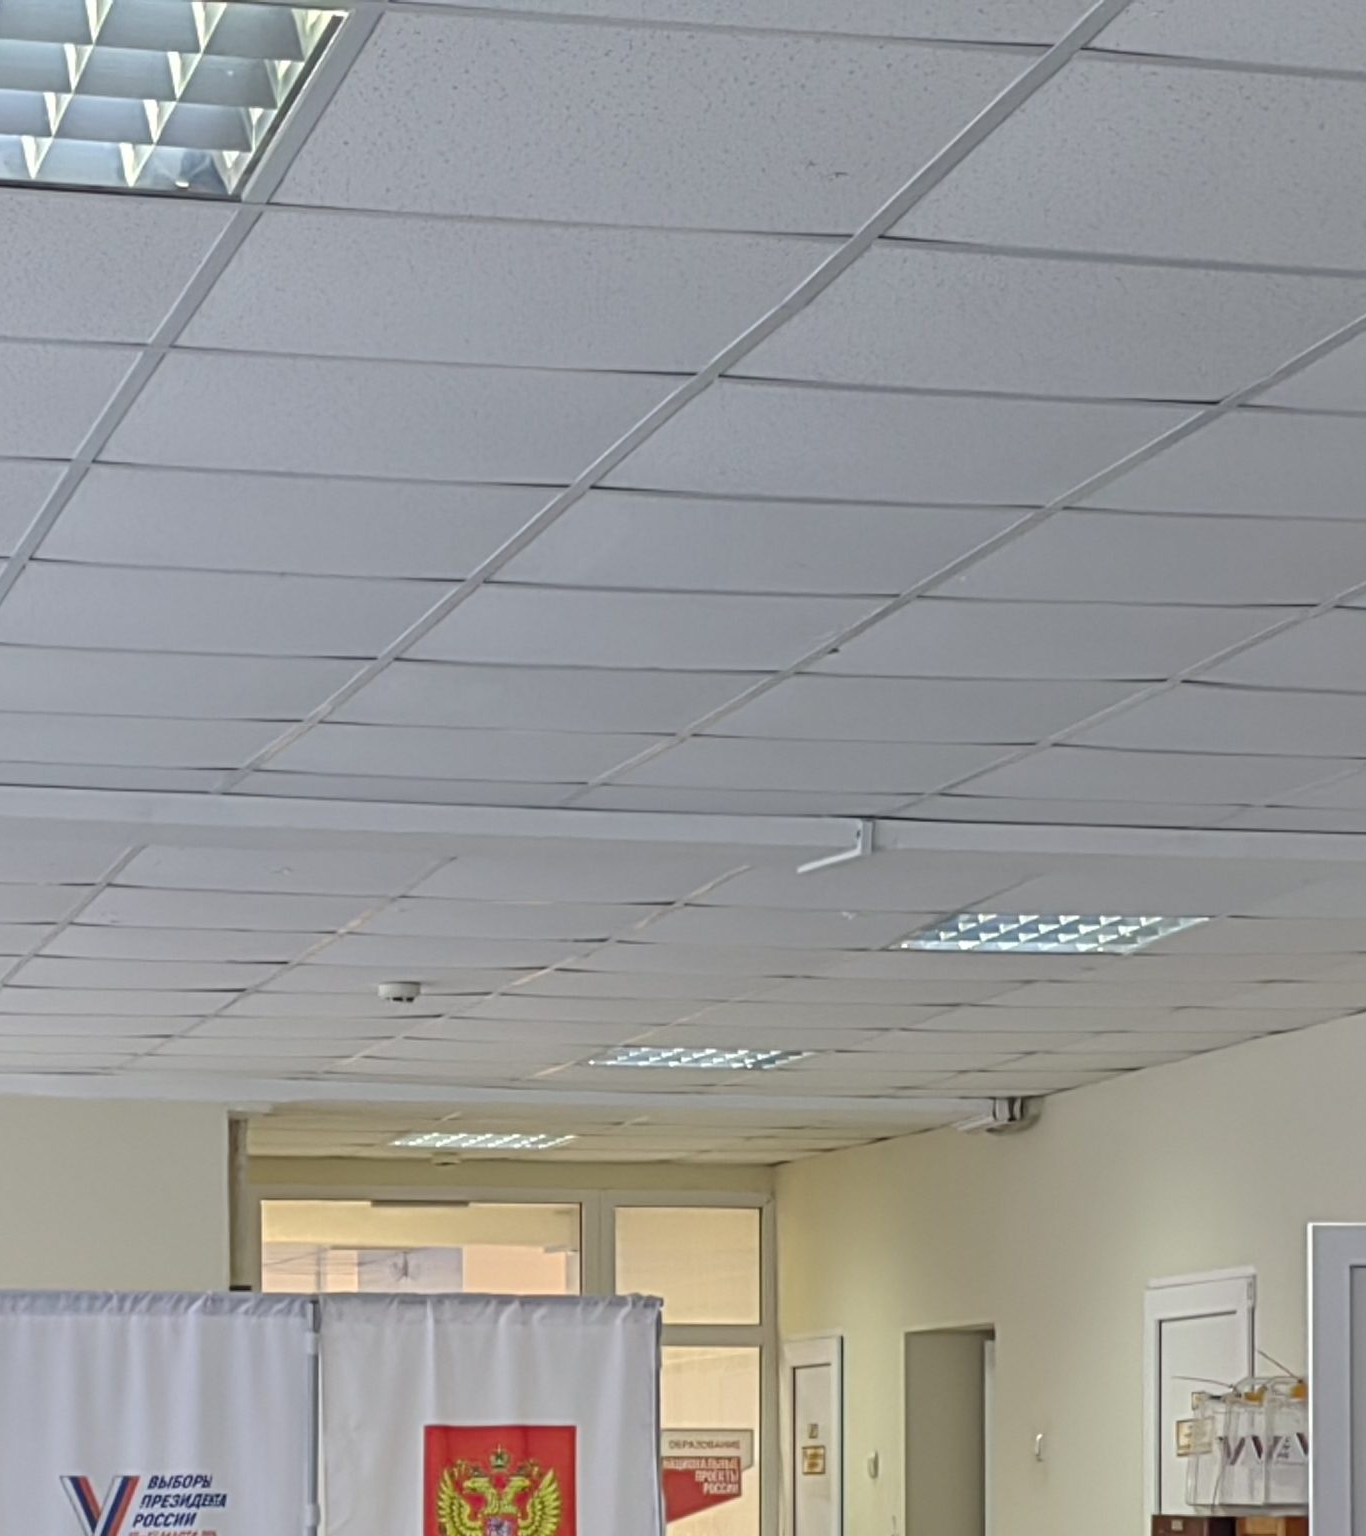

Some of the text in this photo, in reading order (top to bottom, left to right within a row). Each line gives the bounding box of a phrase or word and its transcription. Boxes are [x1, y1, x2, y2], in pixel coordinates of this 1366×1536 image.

[668, 1440, 740, 1450] ОБРАЗОВАНИЕ
[147, 1474, 212, 1490] ВЫБОРЫ
[695, 1470, 738, 1482] ПРОЕКТЫ
[702, 1482, 738, 1495] РОССИИ
[139, 1493, 227, 1509] ПРЕЗИДЕНТА
[132, 1512, 197, 1528] РОССИИ
